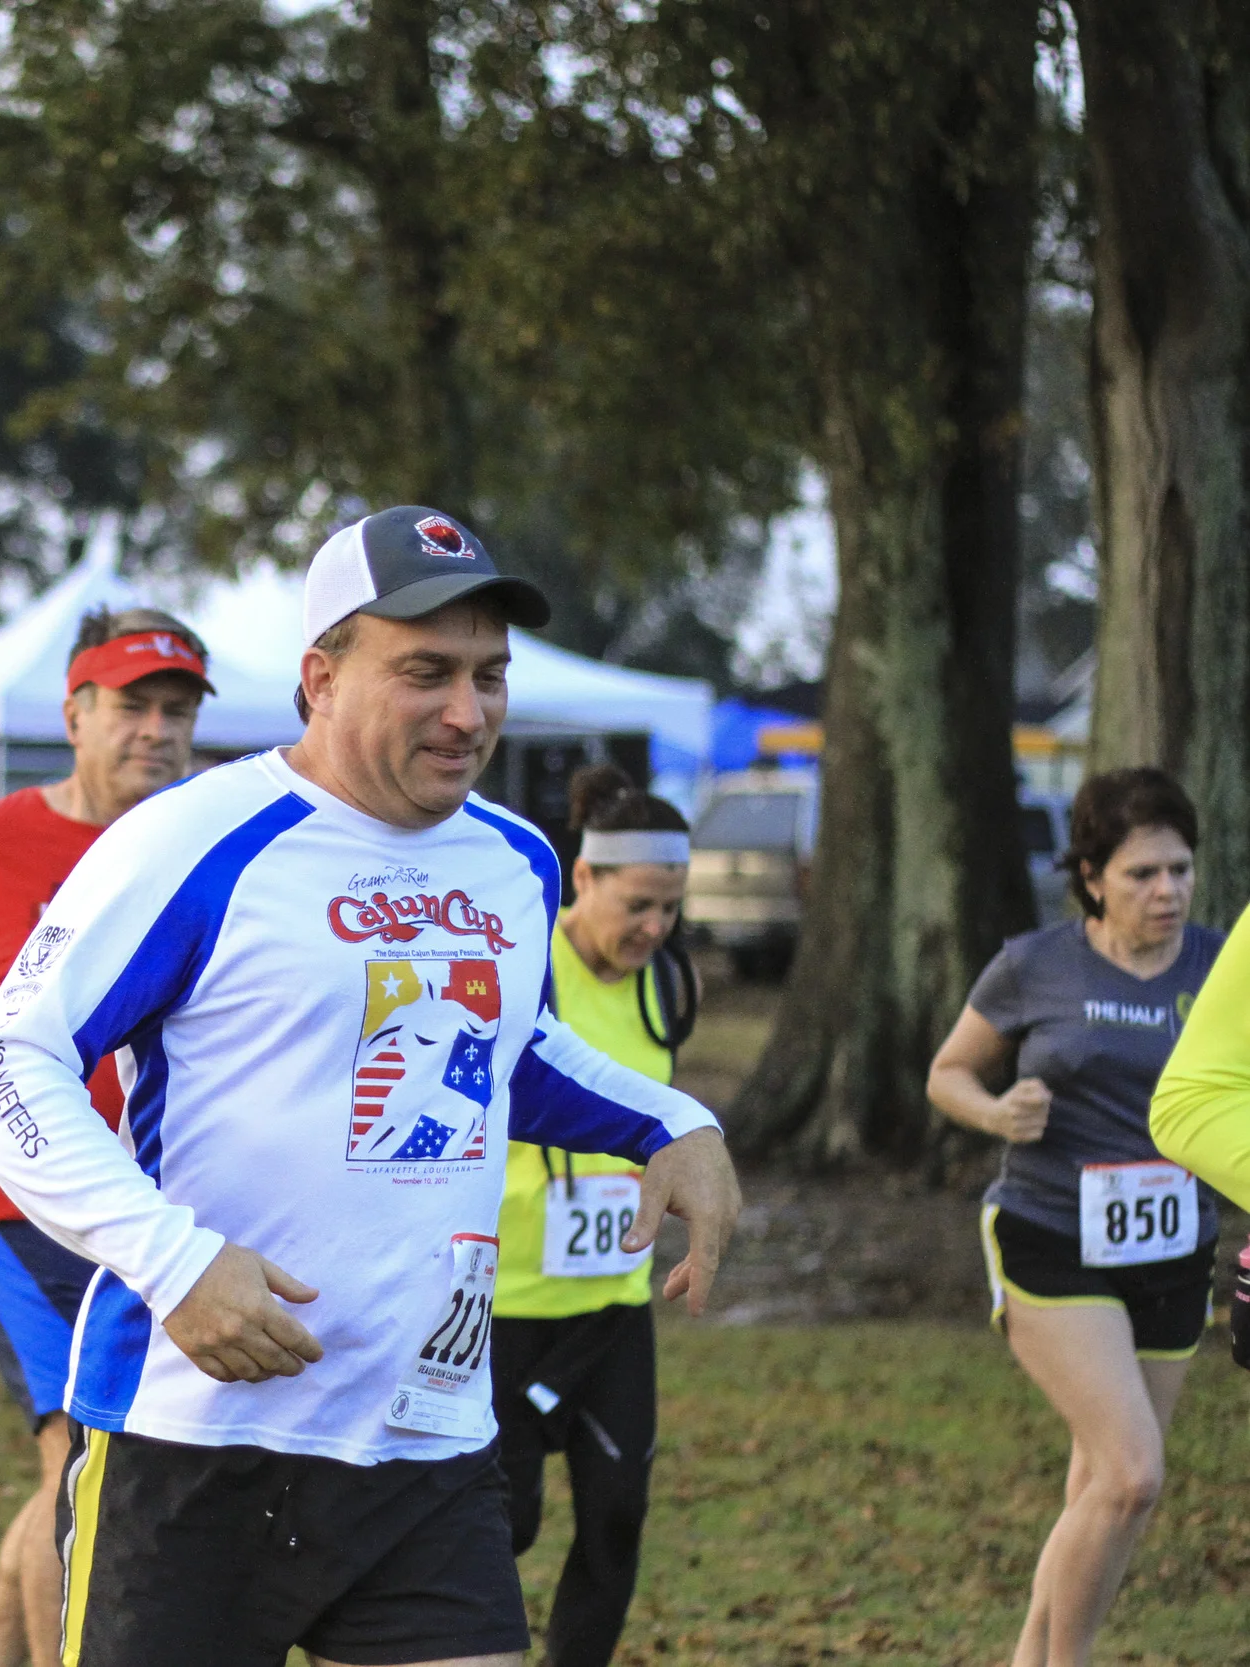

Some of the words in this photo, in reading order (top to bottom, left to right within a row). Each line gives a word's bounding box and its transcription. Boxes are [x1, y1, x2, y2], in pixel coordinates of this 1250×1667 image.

[348, 872, 387, 897] Geaux
[406, 867, 430, 888] Run
[327, 891, 442, 944] Cajun
[440, 889, 517, 956] Cup
[388, 949, 410, 959] Original
[411, 949, 431, 958] Cajun
[431, 949, 458, 958] Running
[1083, 999, 1119, 1022] THE
[1120, 1002, 1167, 1027] HALF
[392, 1177, 422, 1185] November
[434, 1177, 449, 1185] 2012
[423, 1165, 471, 1174] LOUISIANA
[1106, 1194, 1180, 1245] 850
[419, 1287, 494, 1371] 2131
[418, 1364, 437, 1376] GEAUX
[434, 1368, 447, 1378] RUN
[445, 1371, 462, 1382] CAJUN
